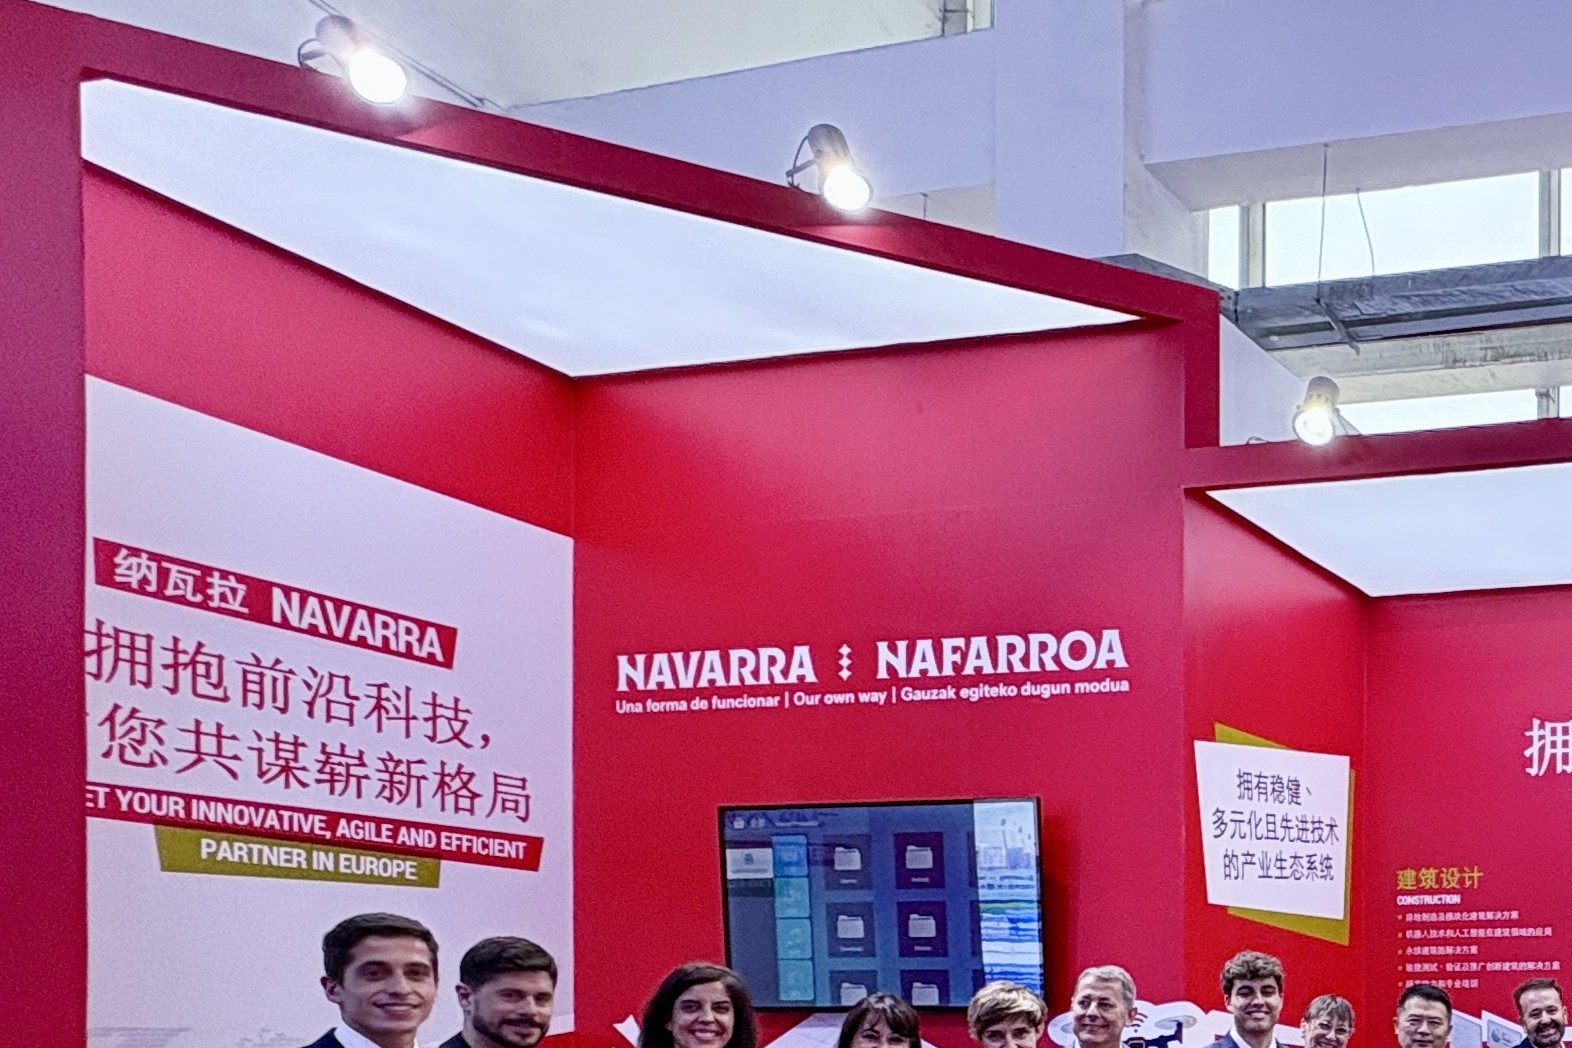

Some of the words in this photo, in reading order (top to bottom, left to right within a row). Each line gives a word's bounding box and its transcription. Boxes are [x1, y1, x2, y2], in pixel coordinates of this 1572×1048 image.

[114, 548, 249, 615] 纳瓦拉
[271, 586, 446, 662] NAVARRA
[616, 644, 818, 693] NAVARRA
[876, 629, 1129, 680] NAFARROA
[615, 700, 644, 714] Una
[646, 698, 688, 713] forma
[689, 696, 709, 711] de
[711, 693, 781, 710] funcionar
[793, 691, 818, 706] Our
[823, 692, 856, 705] own
[857, 691, 888, 706] way
[900, 684, 957, 702] Gauzak
[959, 682, 1018, 702] egiteko
[1020, 680, 1072, 699] dugun
[1074, 677, 1130, 694] modua
[86, 702, 531, 824] 您共谋崭新格局
[115, 789, 186, 819] YOUR
[192, 799, 332, 840] INNOVATIVE,
[336, 818, 394, 844] AGILE
[397, 826, 437, 849] AND
[441, 831, 528, 860] EFFICIENT
[1212, 807, 1340, 846] 多元化且先进技术
[201, 838, 308, 869] PARTNER
[312, 851, 334, 872] IN
[339, 853, 419, 881] EUROPE
[1223, 849, 1335, 881] 的产业生态系统
[1396, 866, 1484, 891] 建筑设计
[1396, 894, 1461, 905] CONSTRUCTION
